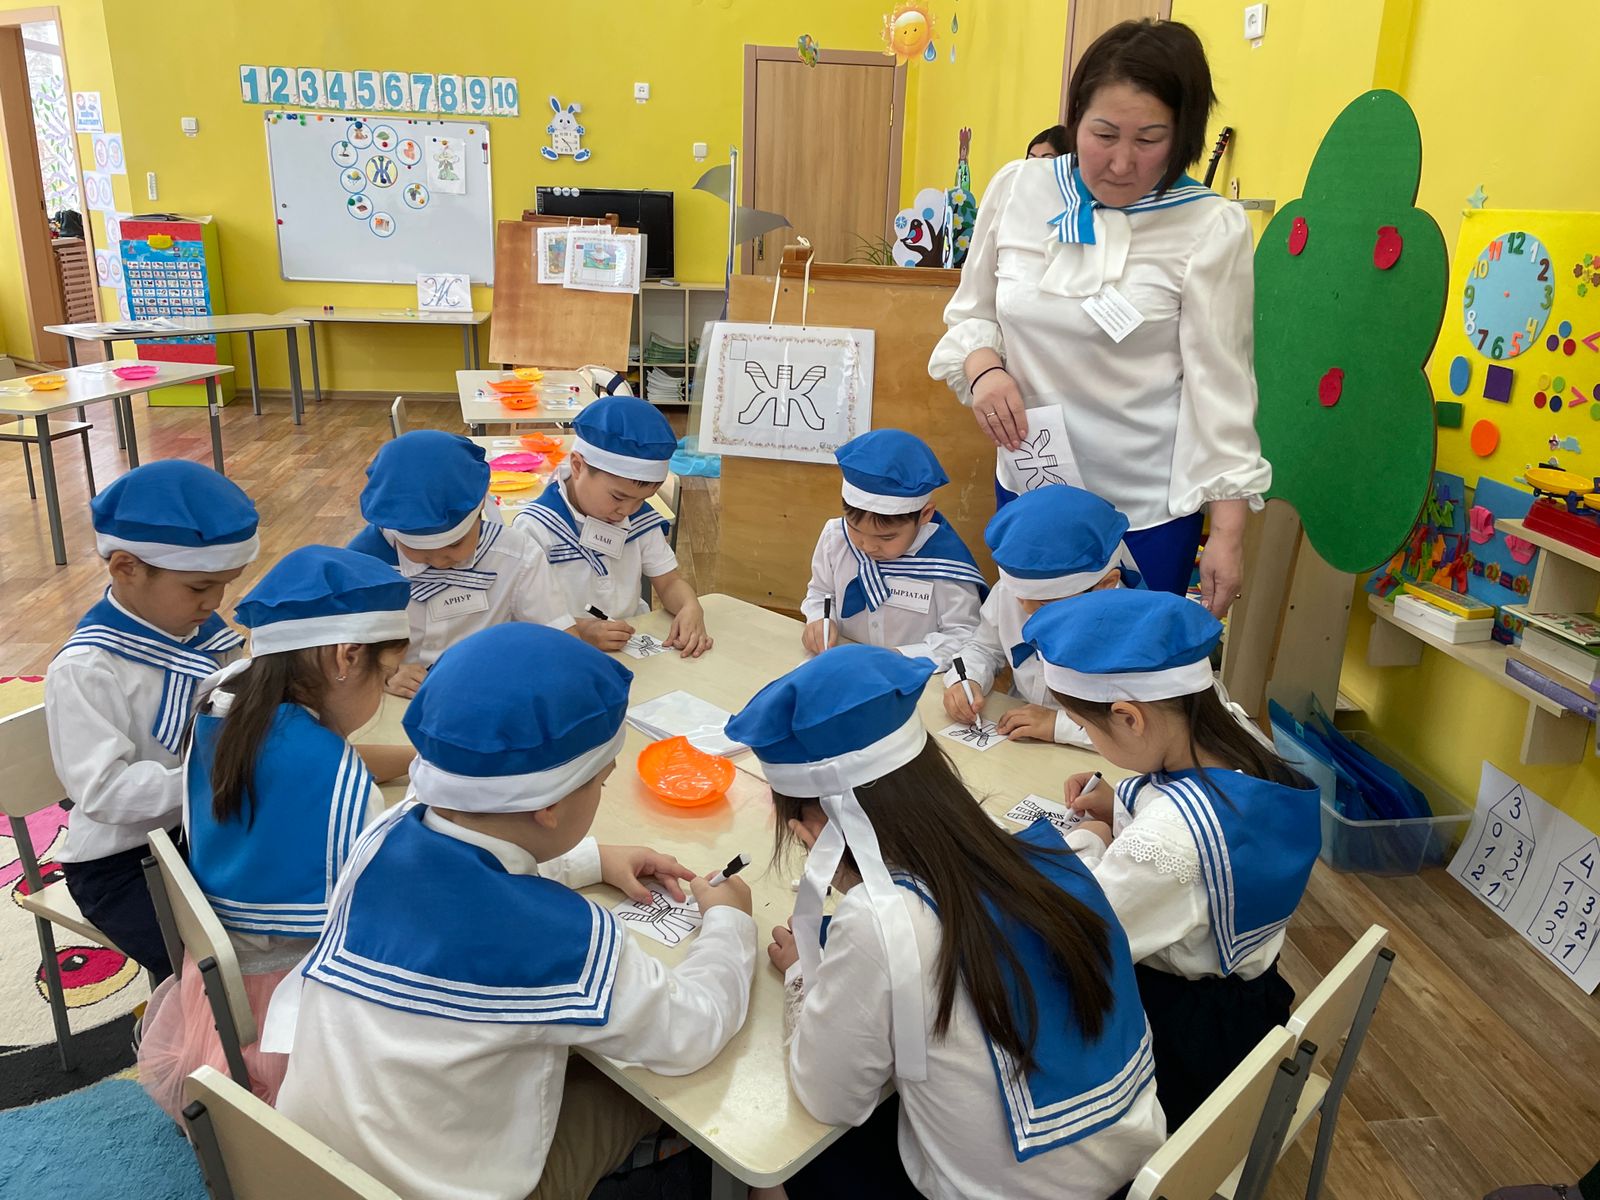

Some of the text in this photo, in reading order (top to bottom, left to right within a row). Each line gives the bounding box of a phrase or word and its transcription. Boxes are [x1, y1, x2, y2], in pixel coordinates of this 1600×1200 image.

[243, 67, 517, 111] 1 2 3 4 5 6 7 8 9 10
[371, 156, 392, 184] Ж
[1488, 240, 1503, 261] 11
[1507, 232, 1526, 255] 12
[1530, 241, 1540, 263] 1
[1473, 259, 1489, 279] 10
[1537, 258, 1550, 281] 2
[421, 277, 463, 306] Ж
[1464, 285, 1475, 309] 9
[1540, 285, 1553, 310] 3
[1465, 310, 1477, 335] 8
[1526, 317, 1538, 342] 4
[1477, 329, 1489, 350] 7
[1491, 336, 1504, 360] 6
[1508, 332, 1523, 357] 5
[738, 360, 827, 431] Ж
[443, 593, 472, 607] АРНУР
[1509, 796, 1522, 819] 3
[1492, 822, 1523, 858] 0 3
[1484, 846, 1519, 881] 1 2
[1579, 853, 1594, 879] 4
[1471, 864, 1501, 896] 2 1
[1563, 881, 1596, 914] 1 3
[1553, 900, 1587, 940] 2 2
[1538, 920, 1576, 959] 3 1
